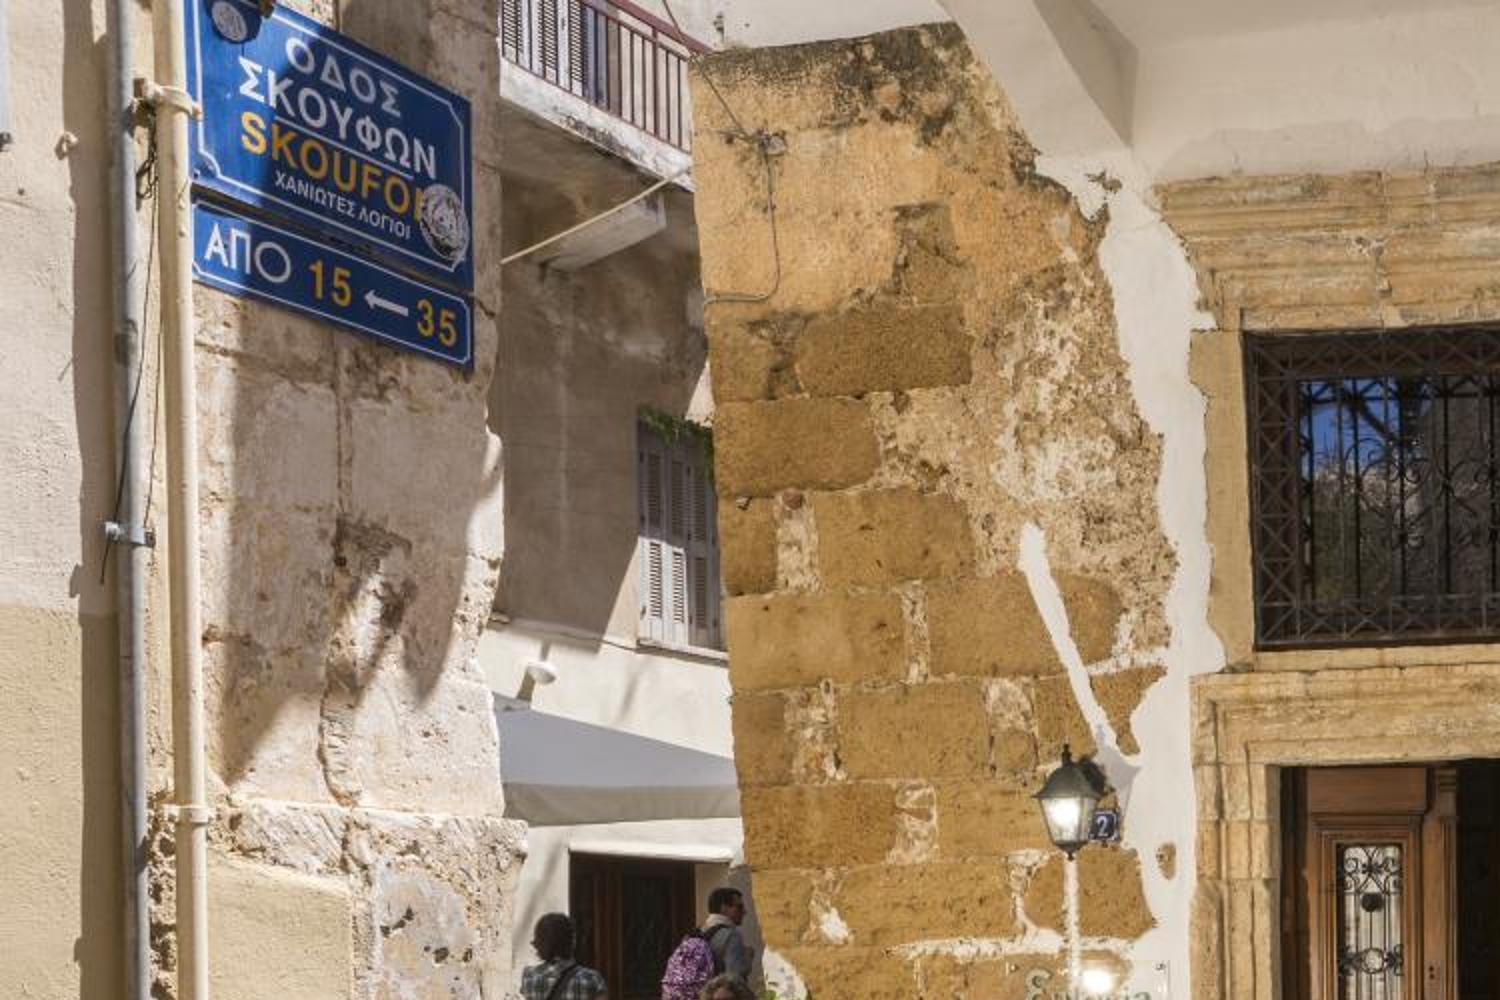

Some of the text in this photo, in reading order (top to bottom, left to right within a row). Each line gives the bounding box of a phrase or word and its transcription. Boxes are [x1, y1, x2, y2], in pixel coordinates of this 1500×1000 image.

[238, 56, 437, 180] ΣΚΟΥΦΩΝ
[285, 36, 402, 119] ΟΔΟΣ
[274, 169, 411, 240] ΧΑΝΙΩΤΕΣ ΛΟΓΙΟΙ
[203, 223, 458, 347] ΑΠΟ 15 35
